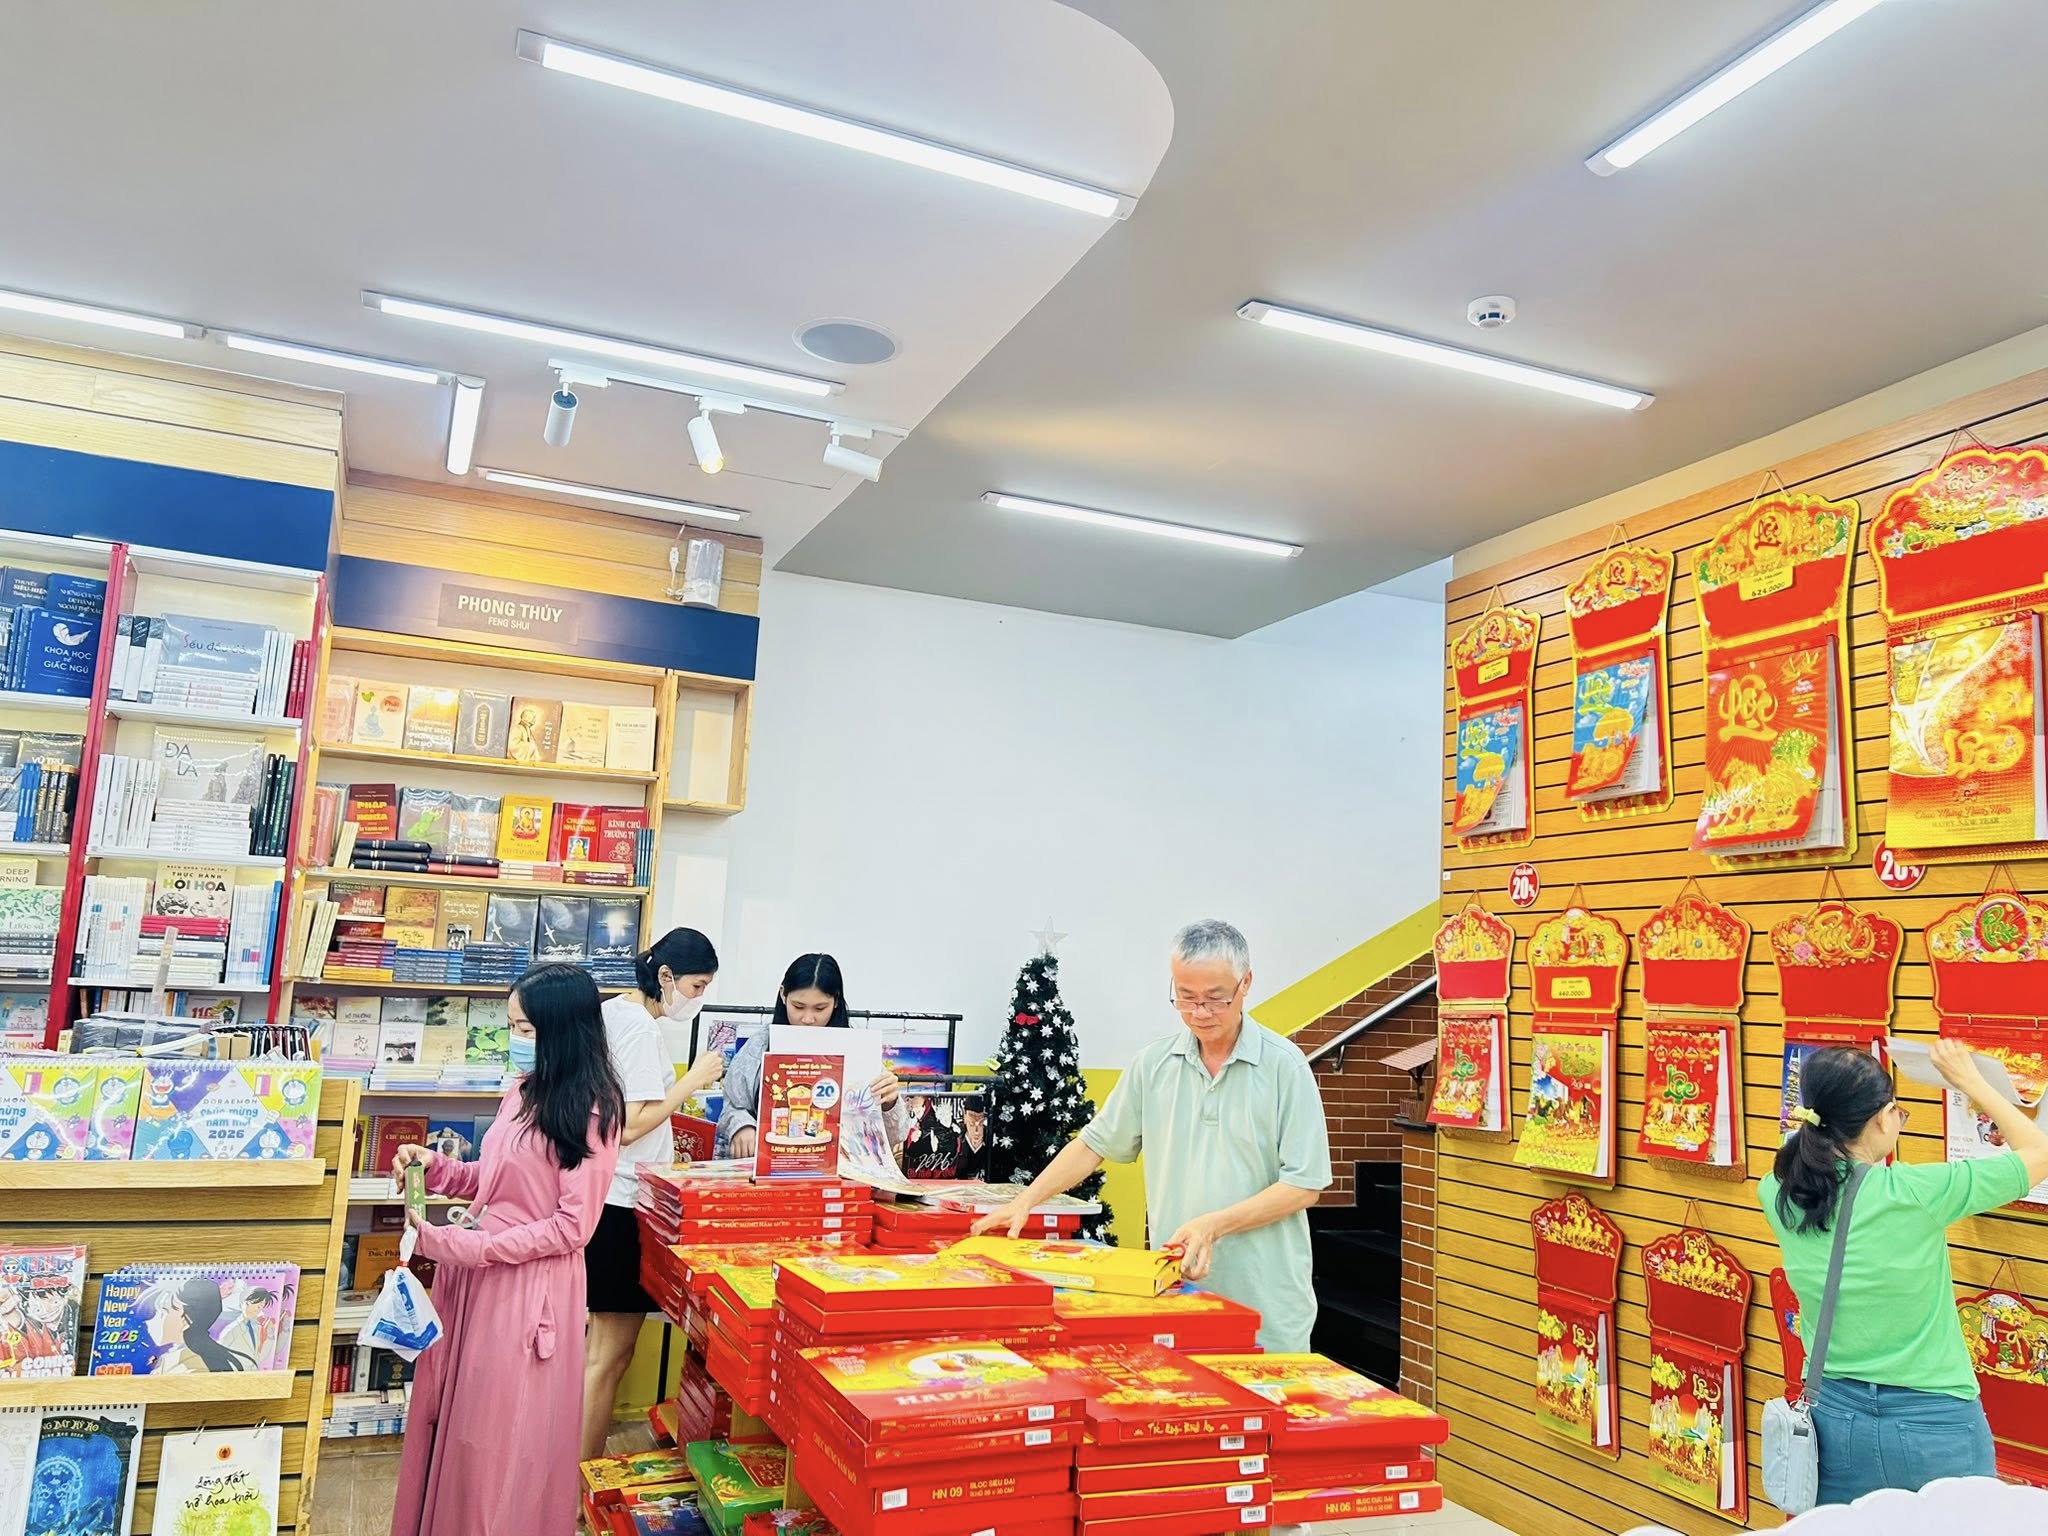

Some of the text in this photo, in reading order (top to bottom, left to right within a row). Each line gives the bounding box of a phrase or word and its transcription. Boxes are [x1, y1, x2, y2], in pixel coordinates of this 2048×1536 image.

[458, 594, 562, 623] PHONG THỦY
[488, 616, 530, 631] FENG SHUI
[44, 646, 92, 661] KHOA HỌC
[1512, 876, 1535, 900] 20%
[18, 1041, 45, 1050] NANG
[815, 1085, 835, 1097] 20
[208, 1129, 244, 1139] 2026
[915, 1152, 951, 1173] 2026
[105, 1284, 140, 1300] Happy
[103, 1300, 128, 1313] New
[103, 1315, 127, 1328] Year
[99, 1329, 139, 1344] 2026
[969, 1481, 988, 1490] BLOC
[932, 1486, 963, 1500] HN 09
[1325, 1503, 1339, 1514] HN
[1339, 1501, 1352, 1512] 06
